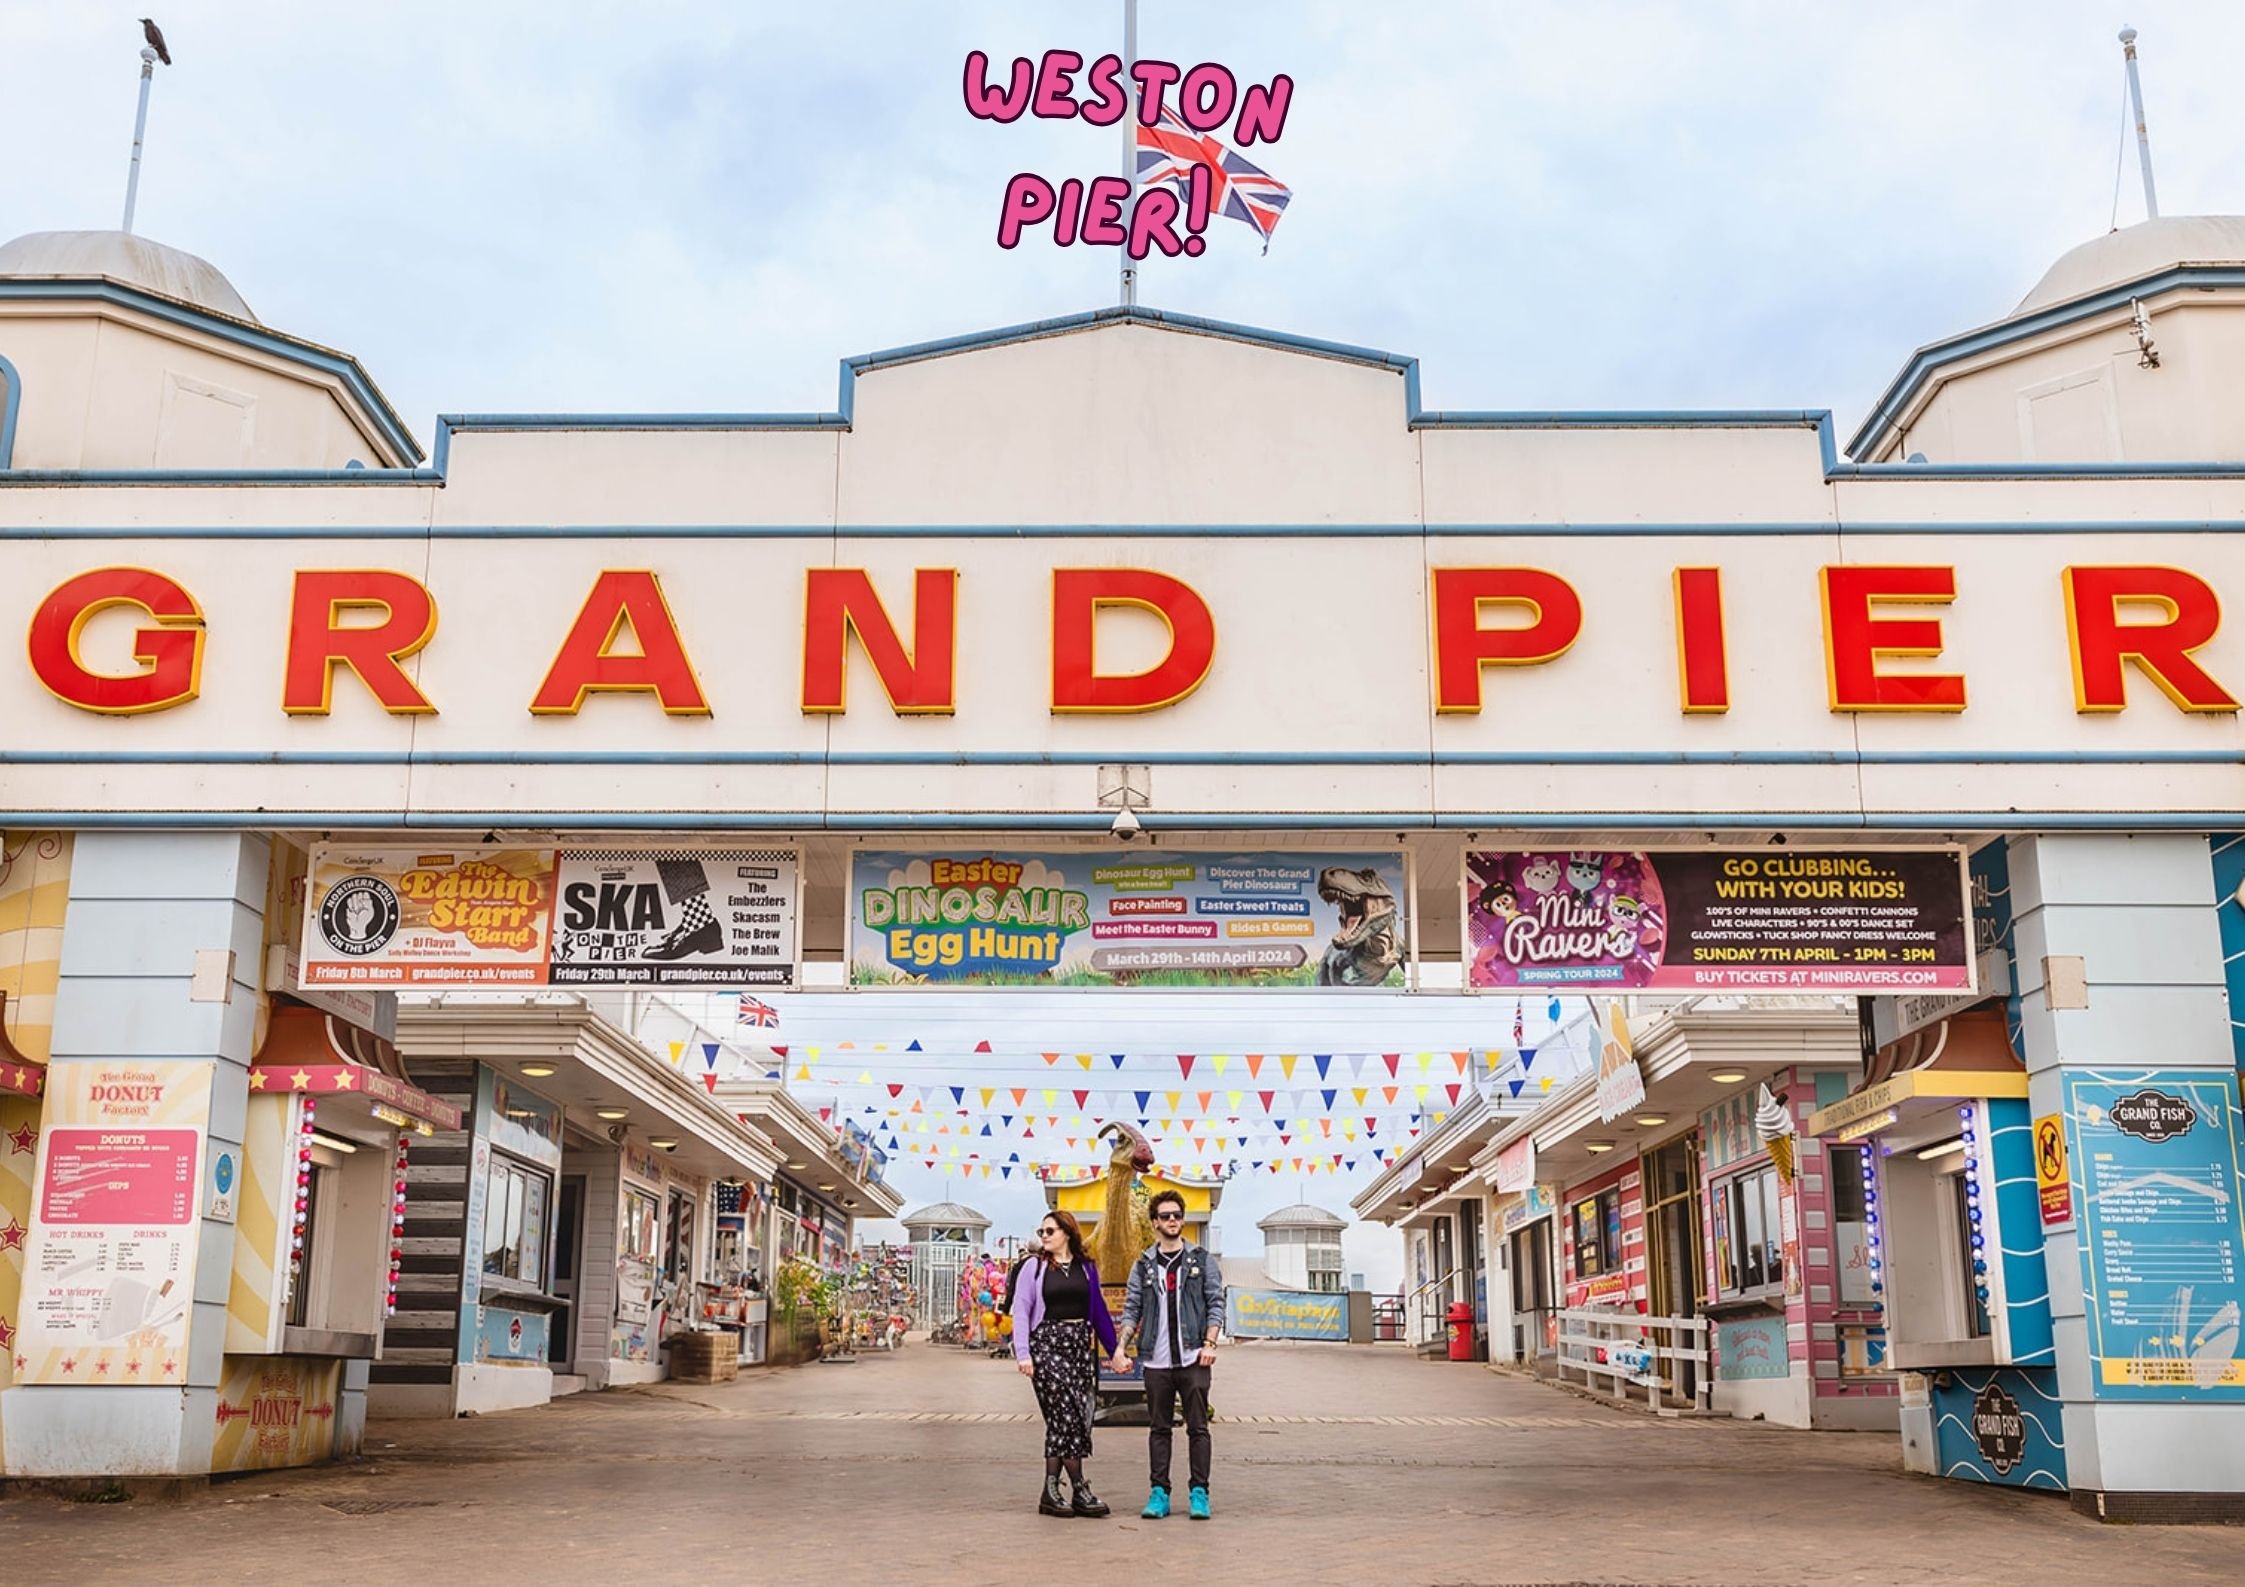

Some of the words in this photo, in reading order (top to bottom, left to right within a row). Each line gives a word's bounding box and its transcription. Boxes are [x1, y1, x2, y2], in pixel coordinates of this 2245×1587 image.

[27, 566, 1217, 719] GRAND
[1430, 565, 2243, 719] PIER
[460, 861, 498, 878] The
[933, 859, 1021, 884] Easter
[1095, 869, 1142, 880] Dinosaur
[1142, 867, 1164, 879] Egg
[1164, 866, 1191, 878] Hunt
[1210, 867, 1256, 878] Discover
[1256, 867, 1277, 878] The
[1277, 868, 1310, 879] Grand
[1723, 858, 1759, 877] GO
[400, 869, 539, 906] Edwin
[748, 882, 767, 893] The
[1222, 879, 1244, 889] Pier
[1245, 879, 1297, 890] Dinosaurs
[1715, 880, 1777, 899] WITH
[1780, 880, 1845, 899] YOUR
[1848, 880, 1906, 899] KIDS!
[326, 878, 376, 908] NORTHERN
[375, 882, 394, 907] SOUL
[563, 882, 666, 931] SKA
[728, 895, 786, 907] Embezzlers
[864, 886, 1089, 928] DINOSAUR
[1112, 900, 1137, 911] Face
[1137, 899, 1183, 911] Painting
[1200, 900, 1234, 911] Easter
[1234, 900, 1269, 911] Sweet
[1270, 901, 1305, 912] Treats
[429, 899, 529, 928] Starr
[1536, 891, 1606, 928] Mini
[1733, 906, 1749, 916] OF
[1749, 906, 1772, 916] MINI
[1772, 906, 1812, 916] RAVERS
[1820, 906, 1869, 916] CONFETTI
[1870, 907, 1919, 916] CANNONS
[732, 912, 781, 923] Skacasm
[1711, 918, 1733, 928] LIVE
[1734, 918, 1798, 928] CHARACTERS
[1860, 919, 1894, 928] DANCE
[1895, 919, 1915, 928] SET
[732, 928, 751, 939] The
[753, 928, 781, 939] Brew
[1094, 924, 1124, 935] Meet
[1124, 923, 1141, 934] the
[1142, 924, 1177, 934] Easter
[1177, 923, 1212, 936] Bunny
[1231, 922, 1261, 933] Rides
[1271, 922, 1309, 933] Games
[467, 926, 530, 947] Band
[578, 934, 600, 946] ON
[616, 934, 647, 946] THE
[1503, 914, 1638, 965] Ravers
[1691, 930, 1755, 940] GLOWSTICKS
[1762, 930, 1790, 940] TUCK
[1790, 930, 1819, 940] SHOP
[1820, 930, 1852, 940] FANCY
[1853, 930, 1885, 940] DRESS
[1885, 930, 1937, 940] WELCOME
[329, 934, 344, 949] ON
[344, 943, 364, 953] THE
[365, 934, 388, 952] PIER
[731, 945, 750, 956] Joe
[751, 945, 780, 956] Malik
[889, 928, 964, 966] Egg
[969, 927, 1060, 961] Hunt
[591, 947, 637, 959] PIER
[1106, 952, 1150, 966] March
[1151, 951, 1183, 964] 29th
[1192, 951, 1220, 963] 14th
[1222, 950, 1256, 966] April
[1257, 950, 1291, 963] 2024
[1693, 947, 1757, 961] SUNDAY
[1759, 947, 1791, 961] 7TH
[1793, 947, 1840, 961] APRIL
[1853, 947, 1887, 961] 1PM
[1901, 947, 1936, 961] 3PM
[316, 966, 349, 980] Friday
[350, 967, 367, 978] 8th
[369, 967, 403, 979] March
[412, 967, 535, 981] grandpier.co.uk/events
[556, 967, 589, 981] Friday
[590, 967, 616, 979] 29th
[617, 967, 650, 980] March
[660, 968, 784, 982] grandpier.co.uk/events
[1523, 969, 1562, 980] SPRING
[1563, 968, 1593, 979] TOUR
[1594, 967, 1619, 978] 2024
[1694, 970, 1725, 983] BUY
[1726, 970, 1787, 983] TICKETS
[1789, 970, 1808, 983] AT
[1810, 970, 1937, 984] MINIRAVERS.COM
[1905, 998, 1919, 1025] THE
[90, 1085, 164, 1102] DONUT
[367, 1073, 397, 1101] DONUTS
[102, 1103, 150, 1117] Factory
[2145, 1098, 2160, 1108] THE
[2120, 1107, 2159, 1121] GRAND
[2160, 1107, 2187, 1121] FISH
[2149, 1120, 2162, 1130] CO.
[100, 1135, 146, 1145] DONUTS
[49, 1231, 68, 1239] HOT
[70, 1231, 105, 1239] DRINKS
[133, 1231, 168, 1239] DRINKS
[48, 1288, 64, 1297] MR
[66, 1289, 104, 1297] WHIPPY
[250, 1399, 301, 1426] DONUT
[2002, 1414, 2020, 1437] FISH
